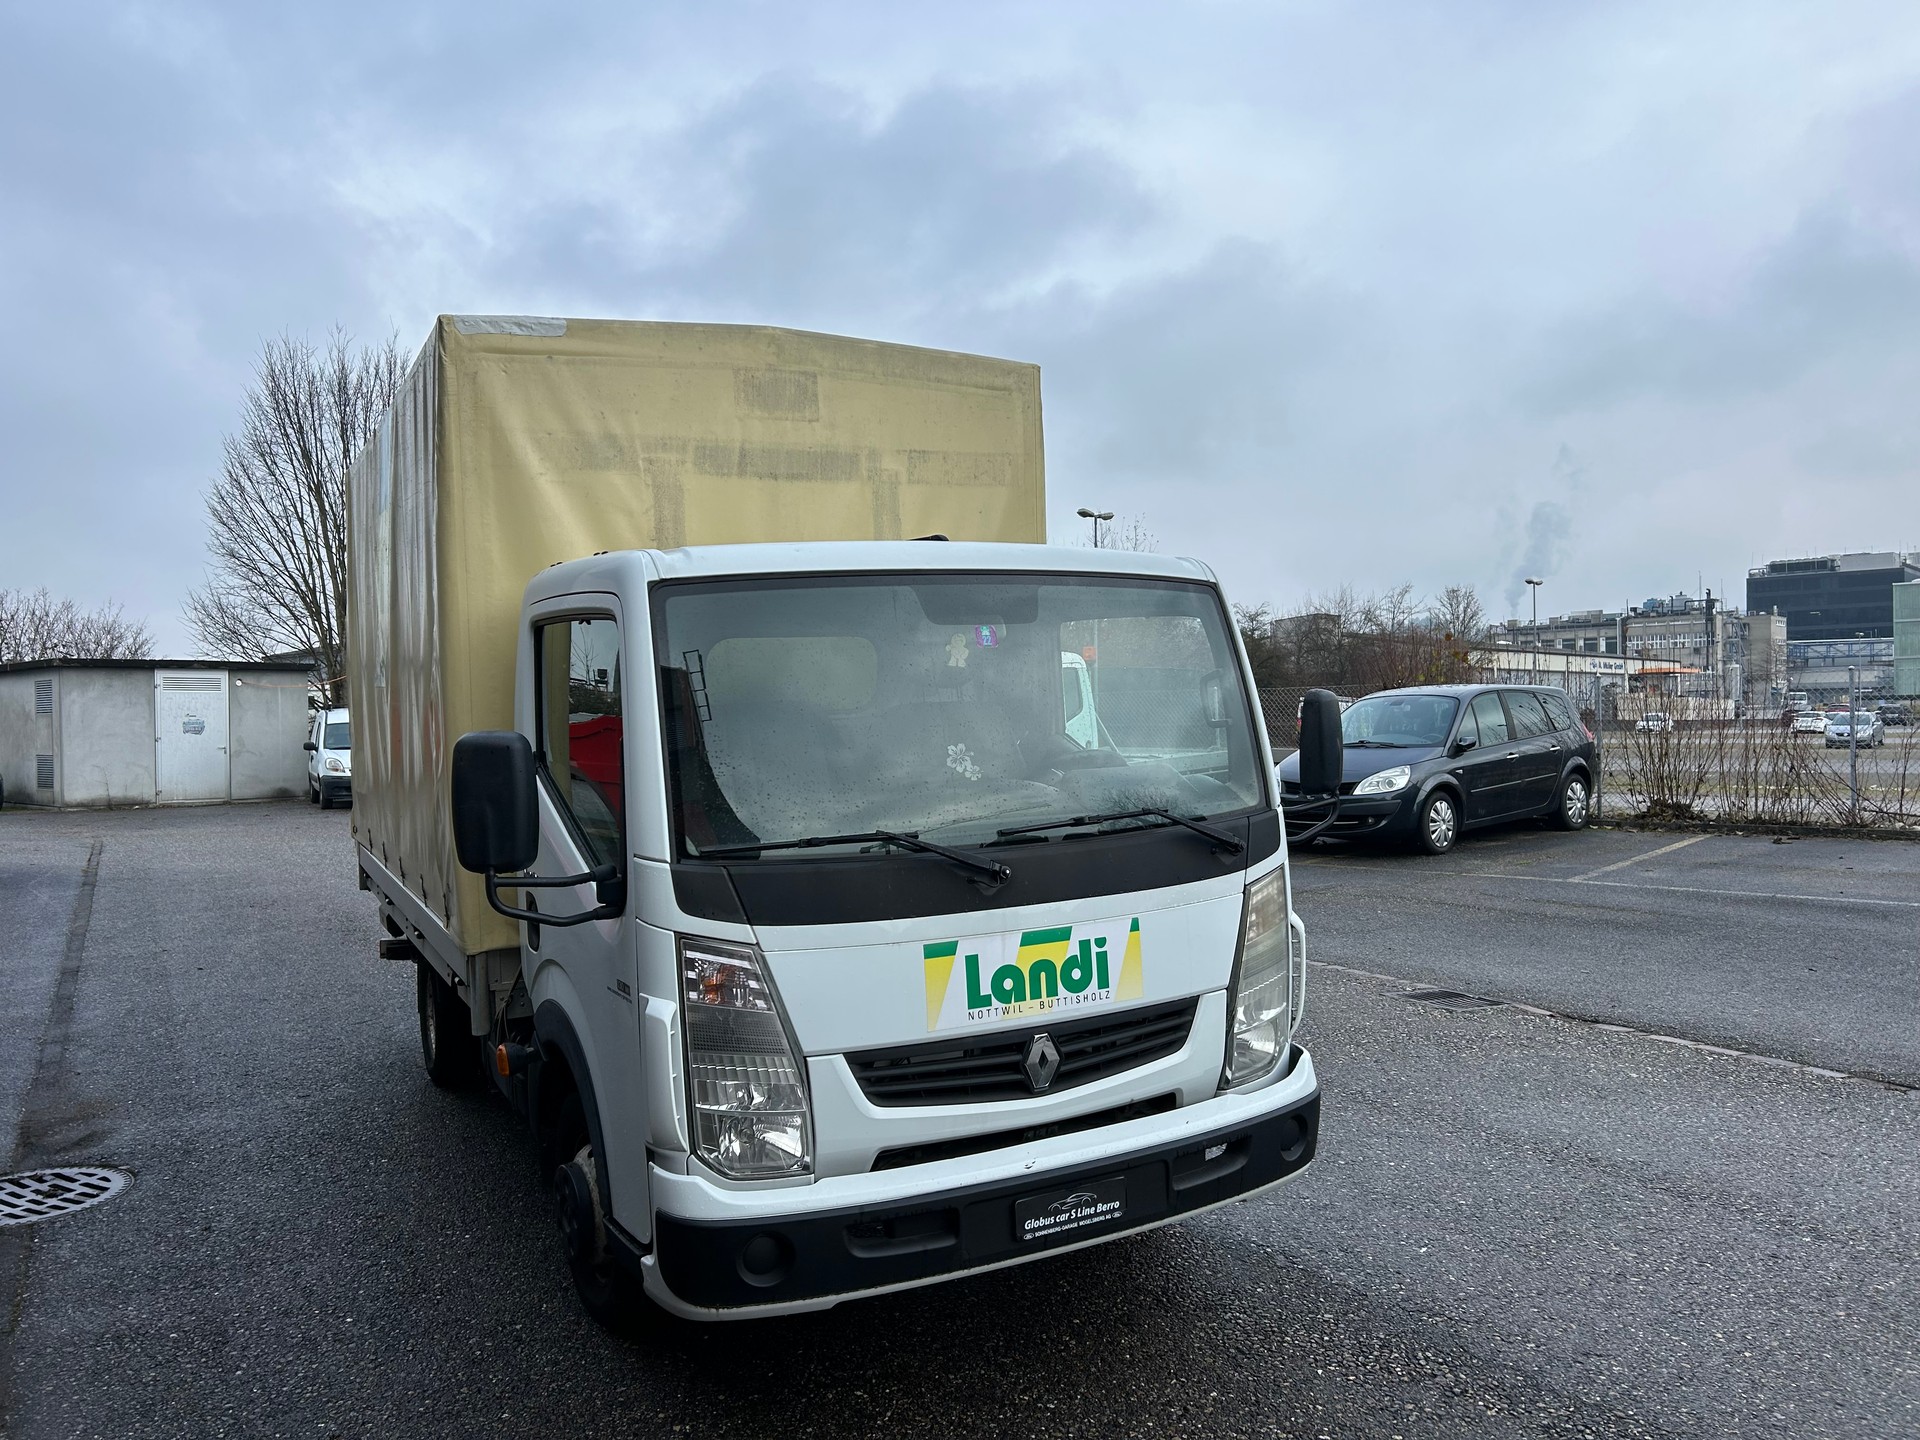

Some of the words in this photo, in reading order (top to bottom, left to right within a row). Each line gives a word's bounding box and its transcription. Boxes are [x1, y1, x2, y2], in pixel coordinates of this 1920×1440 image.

[964, 936, 1110, 1010] Landi
[968, 1004, 1023, 1021] NOTTWIL
[1039, 990, 1111, 1010] BUTTISHOLZ
[1024, 1216, 1055, 1230] Globus
[1055, 1212, 1070, 1223] car
[1070, 1208, 1076, 1219] S
[1077, 1206, 1096, 1217] Line
[1096, 1200, 1120, 1213] Berro
